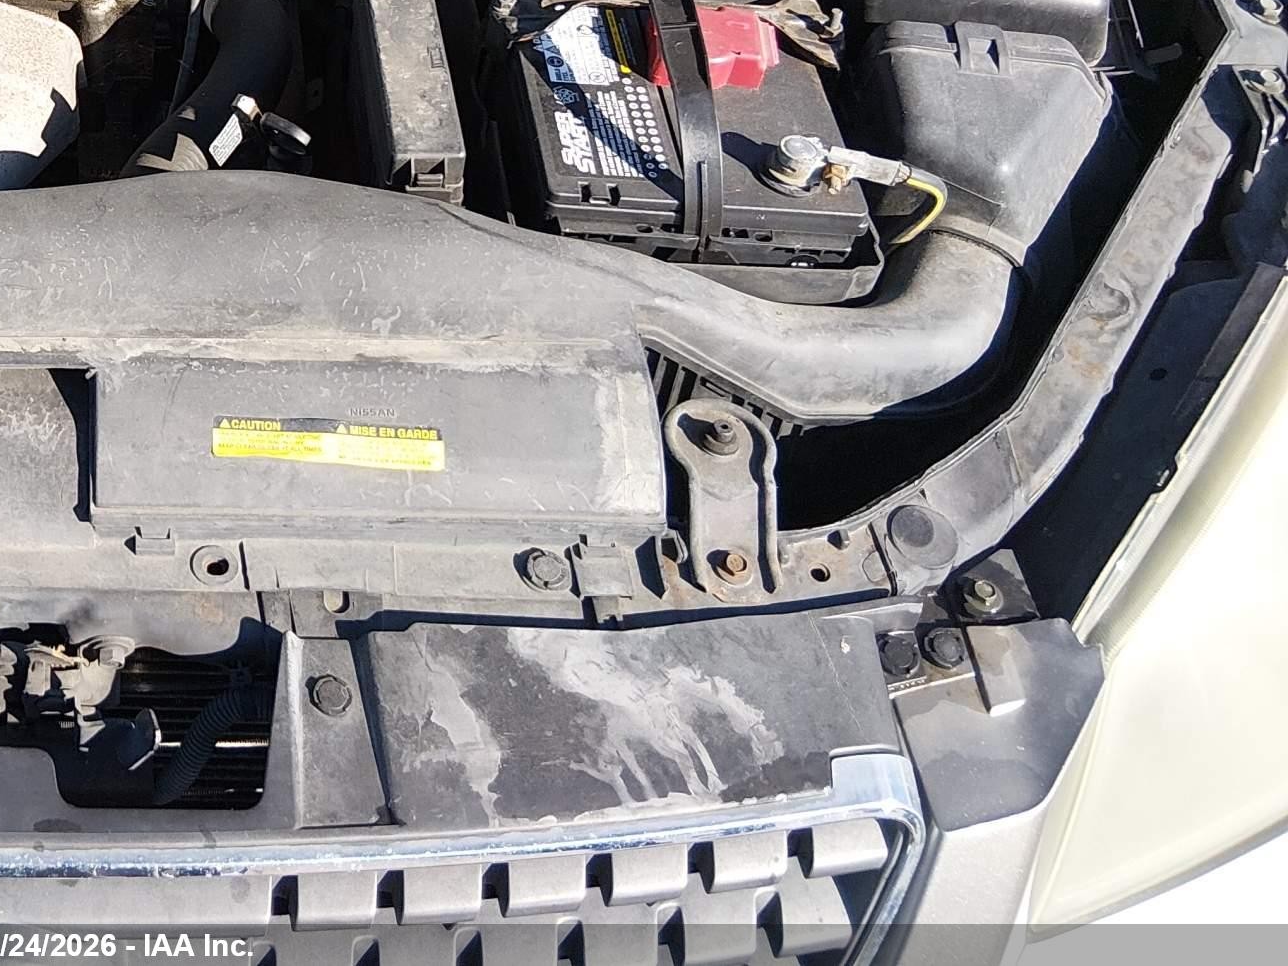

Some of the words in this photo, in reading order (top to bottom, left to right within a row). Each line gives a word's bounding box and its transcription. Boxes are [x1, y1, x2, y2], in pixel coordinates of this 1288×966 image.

[554, 109, 575, 165] SUPER
[570, 115, 597, 175] START
[349, 408, 396, 417] NISSAN
[231, 419, 281, 431] CAUTION
[350, 426, 377, 437] MISE
[380, 427, 394, 438] EN
[397, 428, 438, 440] GARDE
